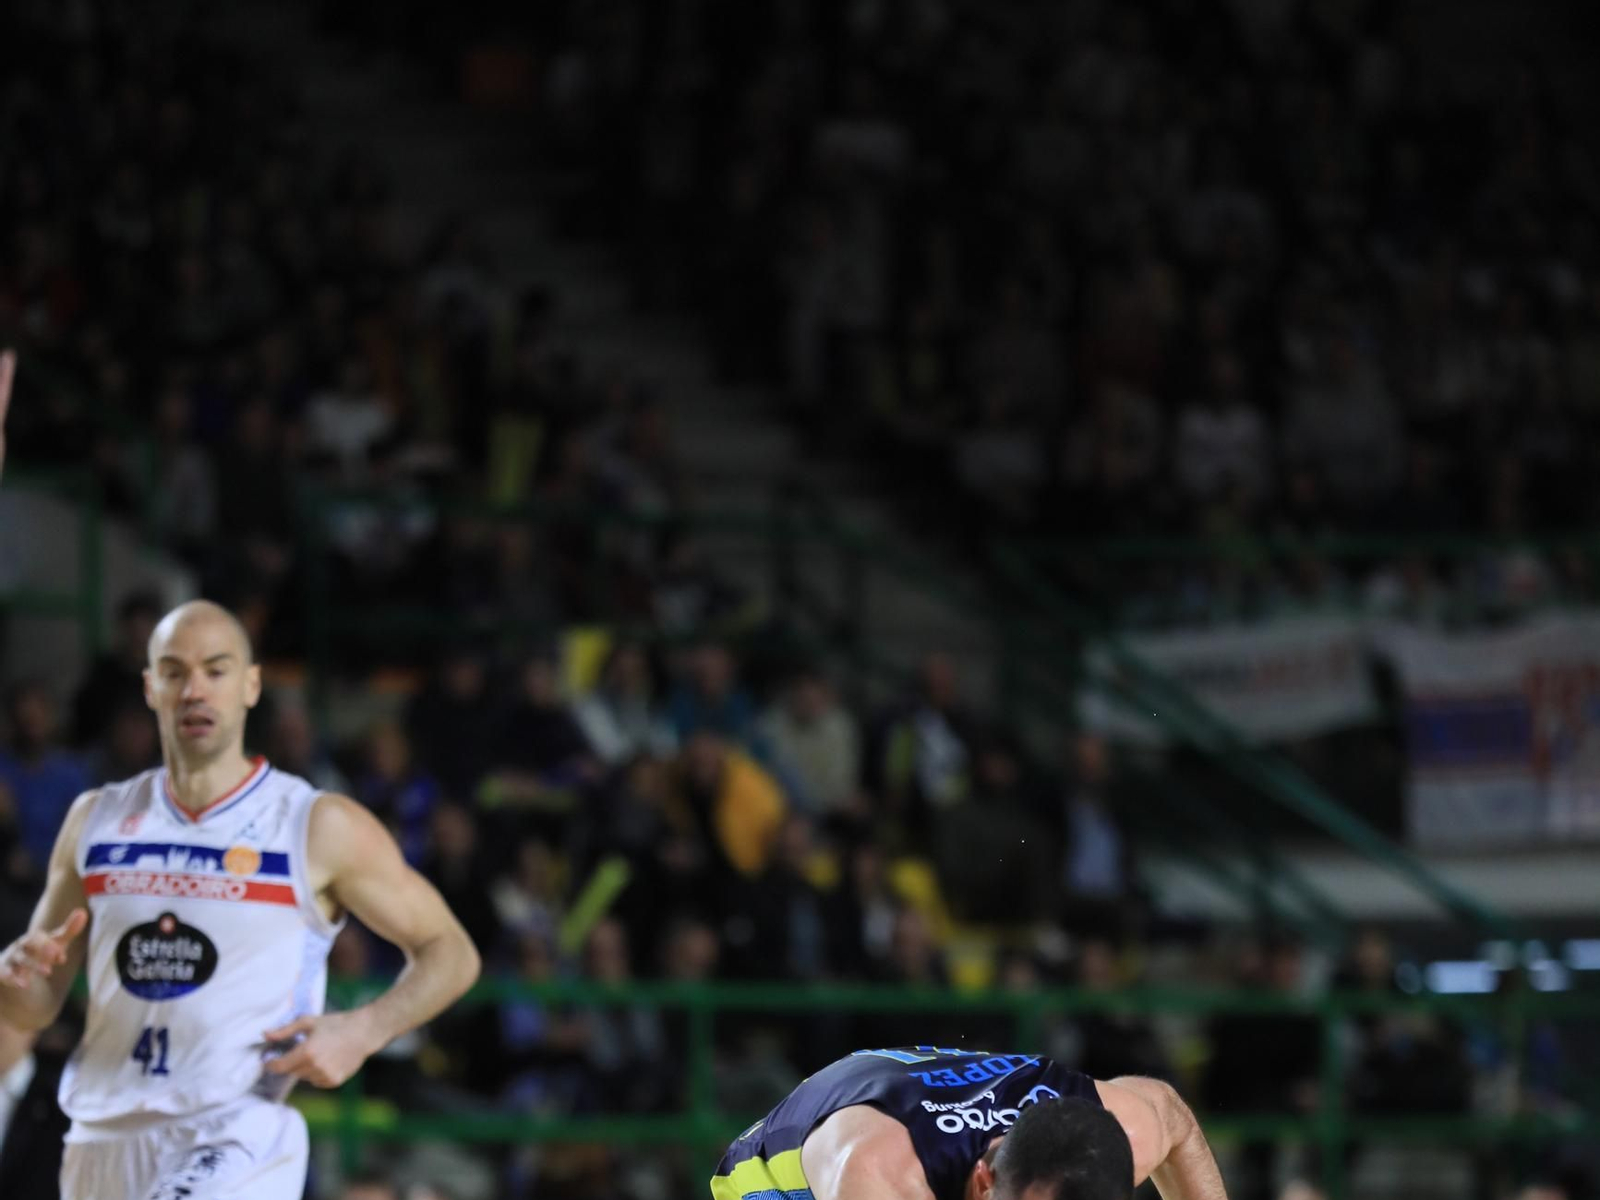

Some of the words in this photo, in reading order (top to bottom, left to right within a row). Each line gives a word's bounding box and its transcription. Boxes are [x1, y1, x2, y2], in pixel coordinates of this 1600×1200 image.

[129, 934, 204, 961] Estrella
[132, 1025, 170, 1077] 41
[908, 1054, 1041, 1088] LOPEZ
